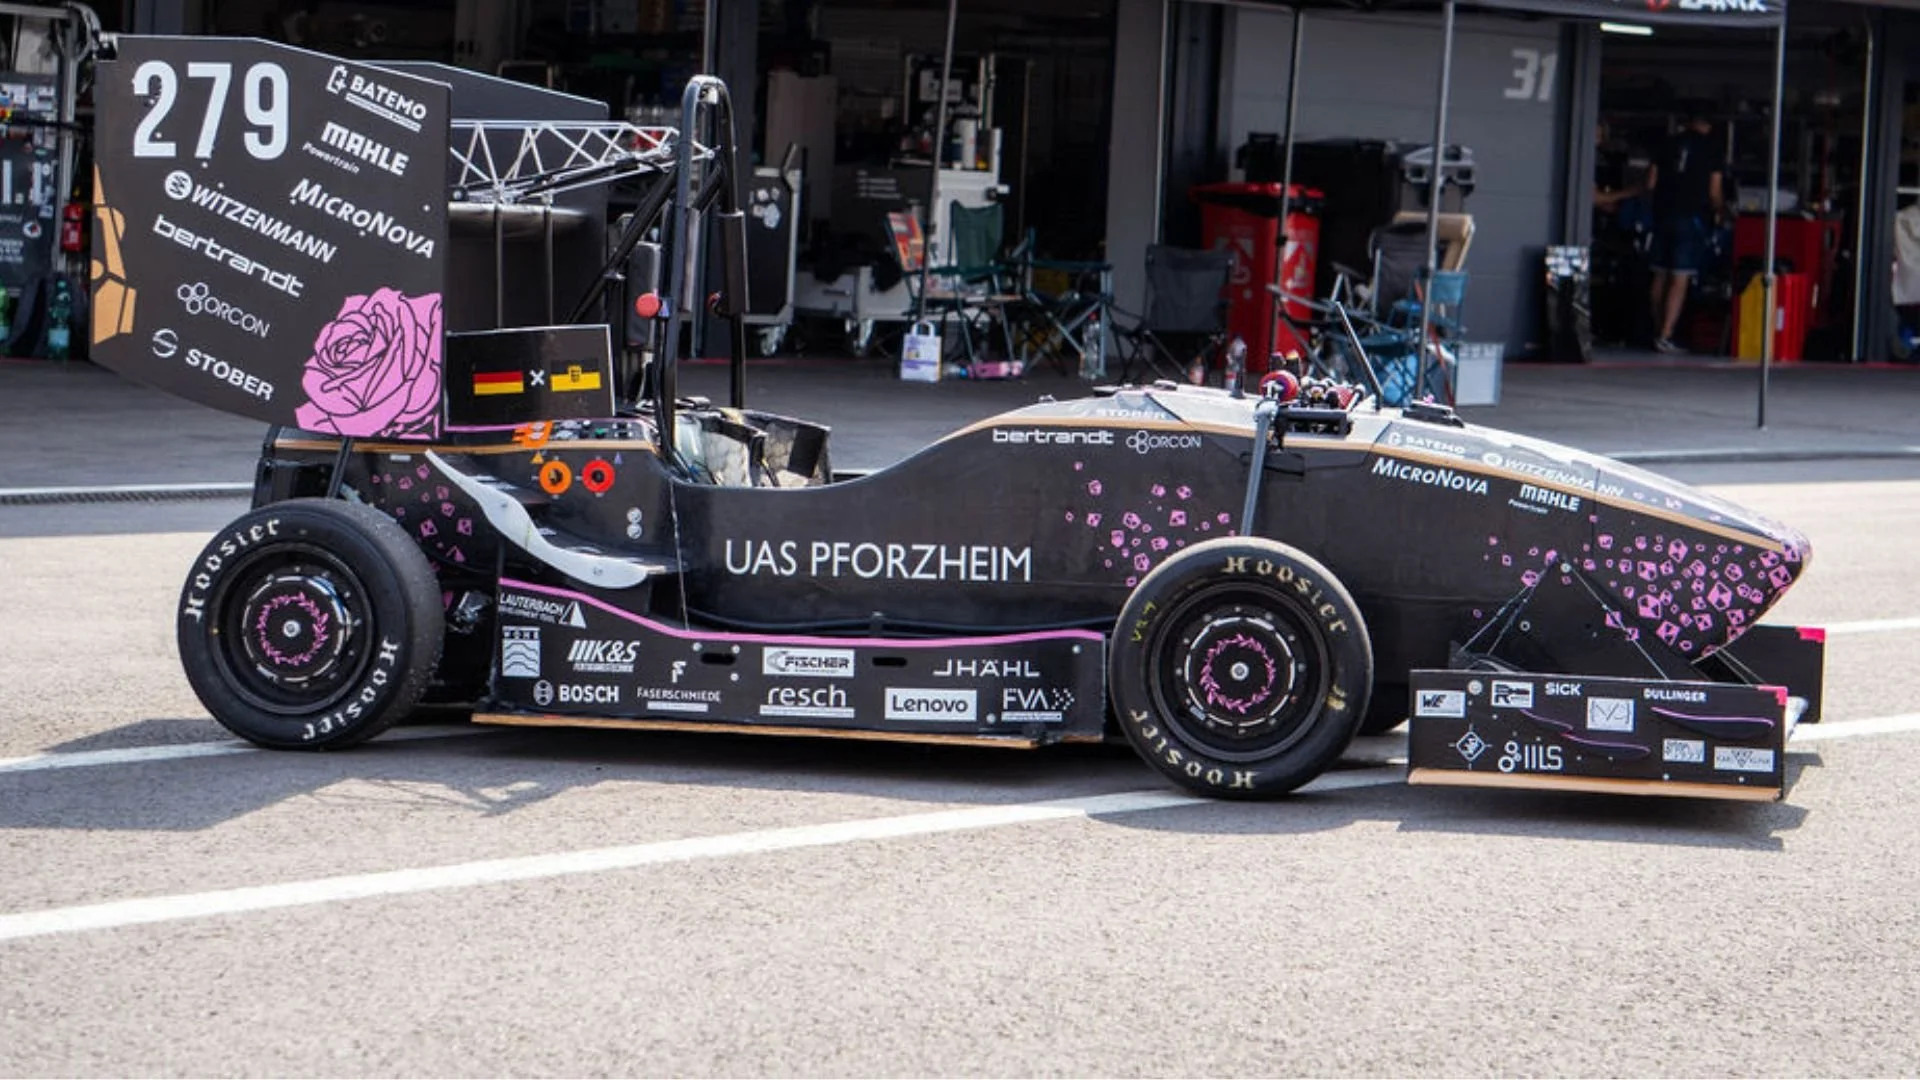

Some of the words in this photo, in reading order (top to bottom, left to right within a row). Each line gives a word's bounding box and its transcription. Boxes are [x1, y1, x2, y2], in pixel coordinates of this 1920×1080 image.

[1504, 47, 1559, 102] 31
[132, 60, 290, 160] 279
[349, 74, 428, 121] BATEMO
[320, 121, 410, 176] MAHLE
[191, 184, 337, 263] WITZENMANN
[153, 213, 304, 298] bertrandt
[204, 297, 270, 339] ORCON
[992, 429, 1114, 445] bertrandt
[1149, 435, 1201, 449] ORCON
[1519, 484, 1580, 513] MAHLE
[725, 540, 797, 577] UAS
[810, 541, 1031, 582] PFORZHEIM
[499, 592, 564, 617] LAUTERBACH
[559, 683, 620, 702] BOSCH
[636, 685, 722, 704] FASERSCHMIEDE
[767, 683, 847, 708] resch
[1002, 687, 1049, 711] FVA
[1544, 681, 1582, 697] SICK
[891, 694, 970, 713] Lenovo
